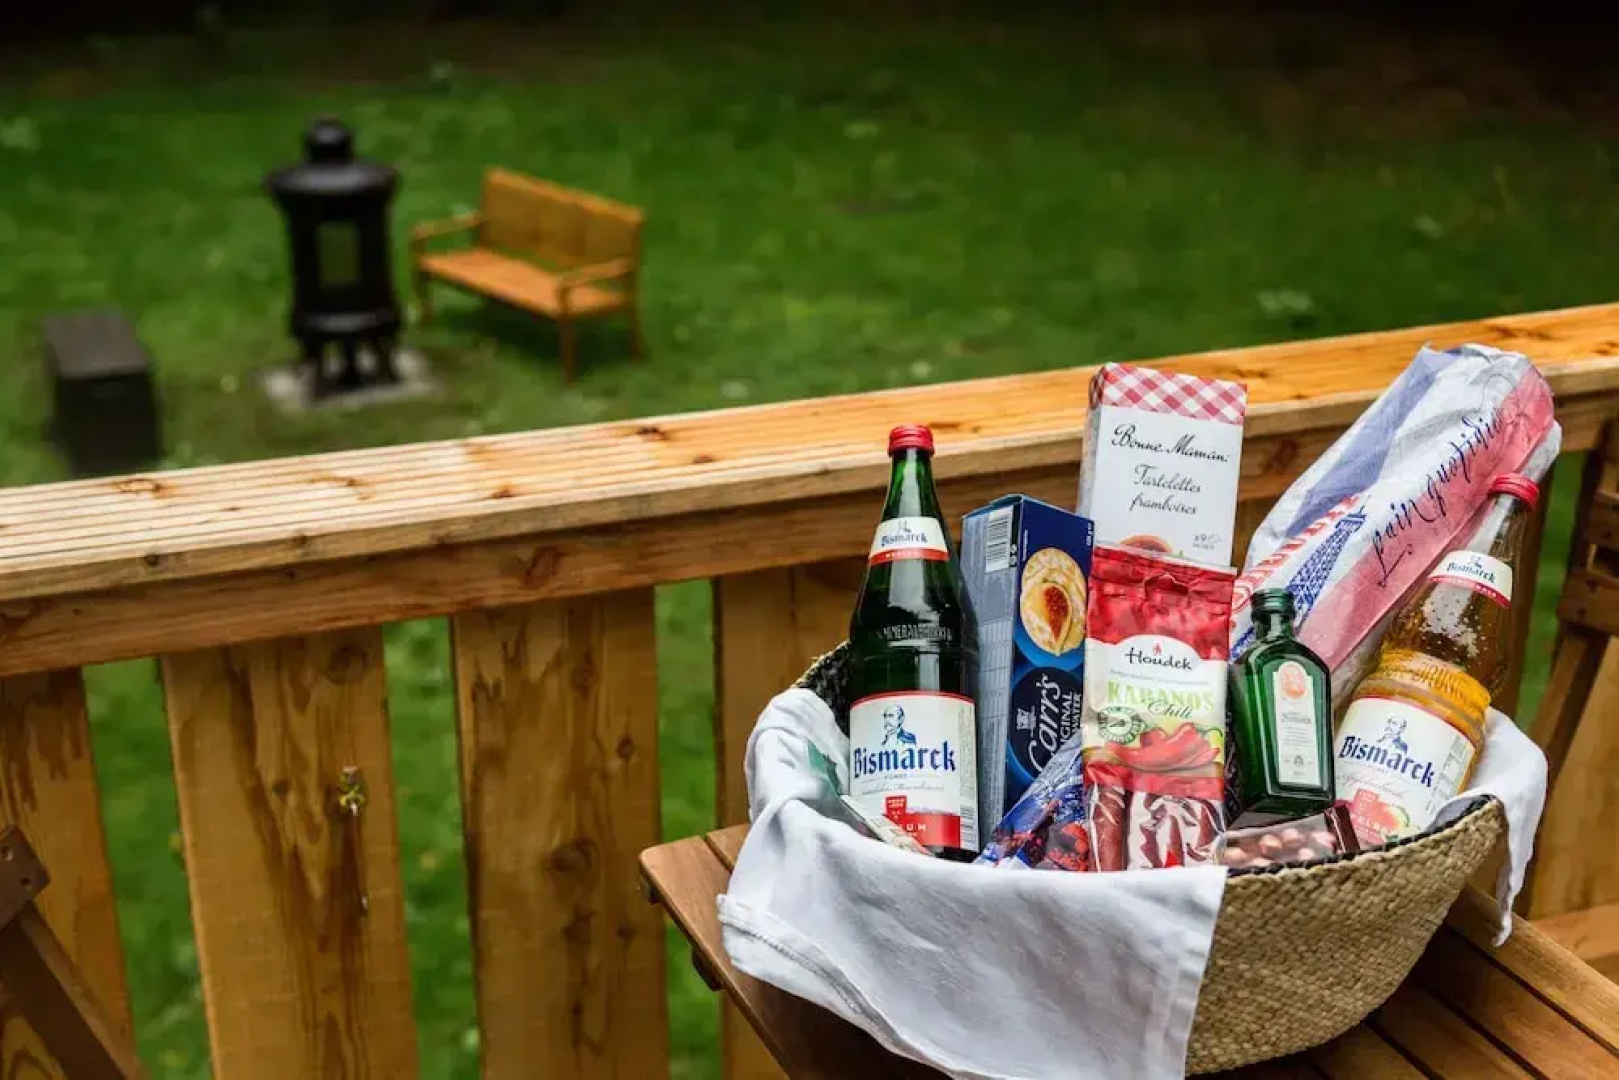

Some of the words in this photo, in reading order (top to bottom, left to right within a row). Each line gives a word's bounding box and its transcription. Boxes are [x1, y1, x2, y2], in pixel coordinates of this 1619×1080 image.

[1111, 423, 1164, 453] Bonne
[1134, 463, 1202, 493] Tartelettes
[1129, 491, 1198, 517] framboises
[881, 532, 927, 547] Bismarck
[1446, 562, 1496, 583] Bismarck
[1125, 647, 1192, 670] Houdek
[1028, 673, 1061, 772] Carr's
[1147, 699, 1192, 719] Chili
[854, 741, 956, 778] Bismarck
[1339, 736, 1434, 787] Bismarck
